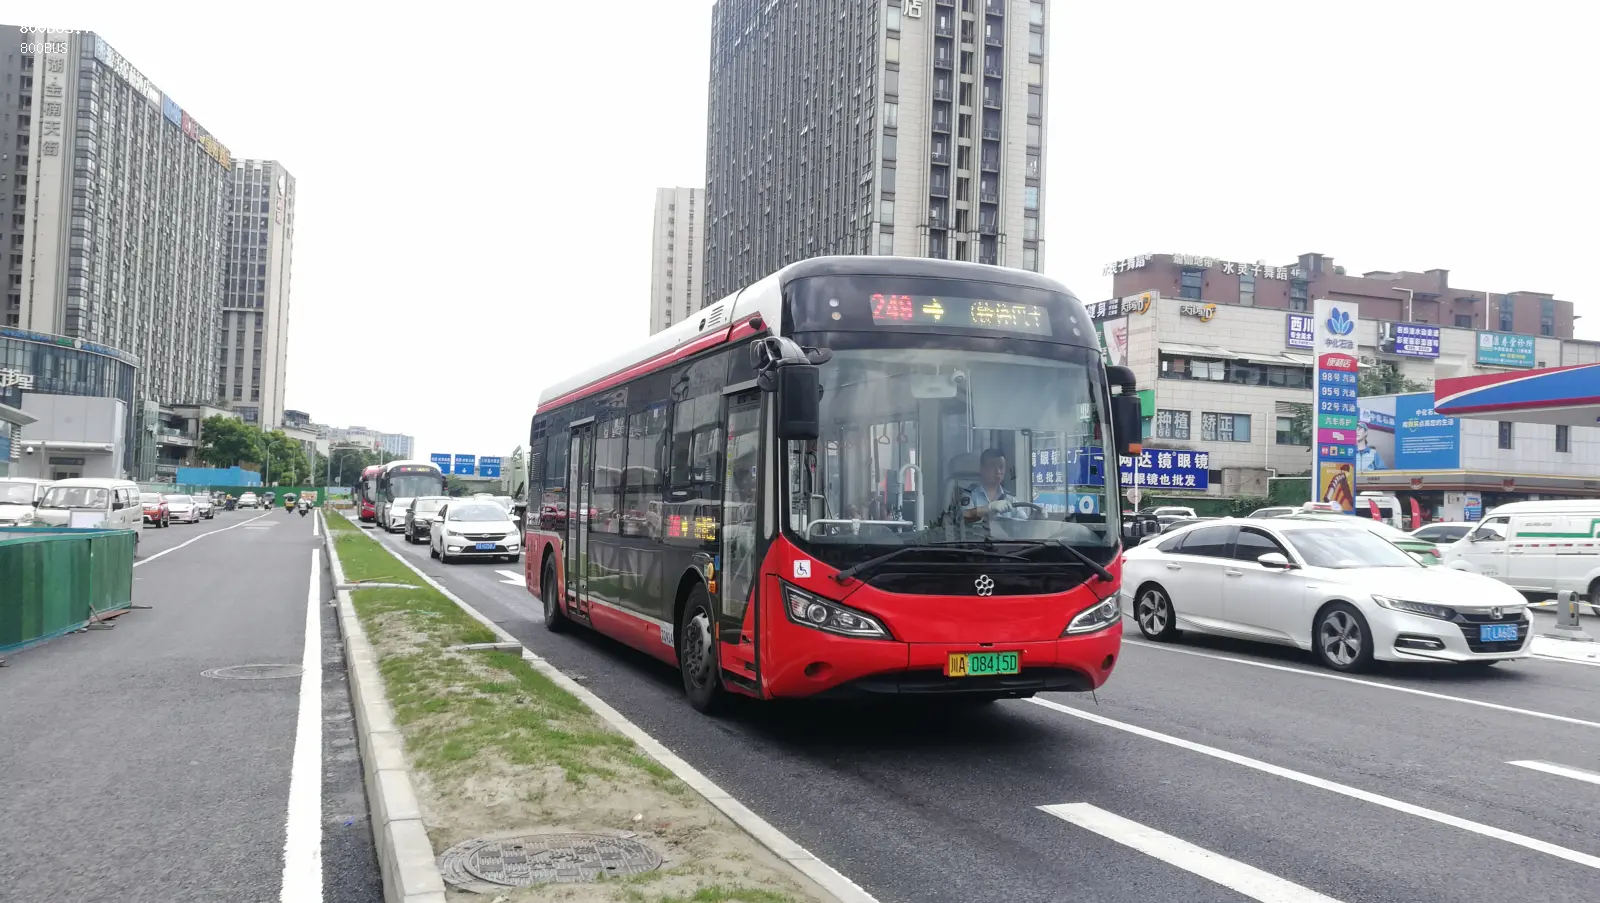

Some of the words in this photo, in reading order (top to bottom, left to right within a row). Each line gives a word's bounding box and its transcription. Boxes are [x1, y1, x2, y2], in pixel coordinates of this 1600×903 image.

[1223, 261, 1288, 280] 水灵子舞蹈
[1290, 316, 1314, 333] 西川
[1322, 372, 1340, 382] 98号
[1342, 374, 1356, 383] 汽油
[1321, 387, 1340, 397] 95号
[1342, 389, 1356, 398] 汽油
[1321, 401, 1340, 411] 92号
[1342, 403, 1356, 412] 汽油
[1157, 411, 1188, 429] 种植
[1202, 414, 1233, 432] 矫正
